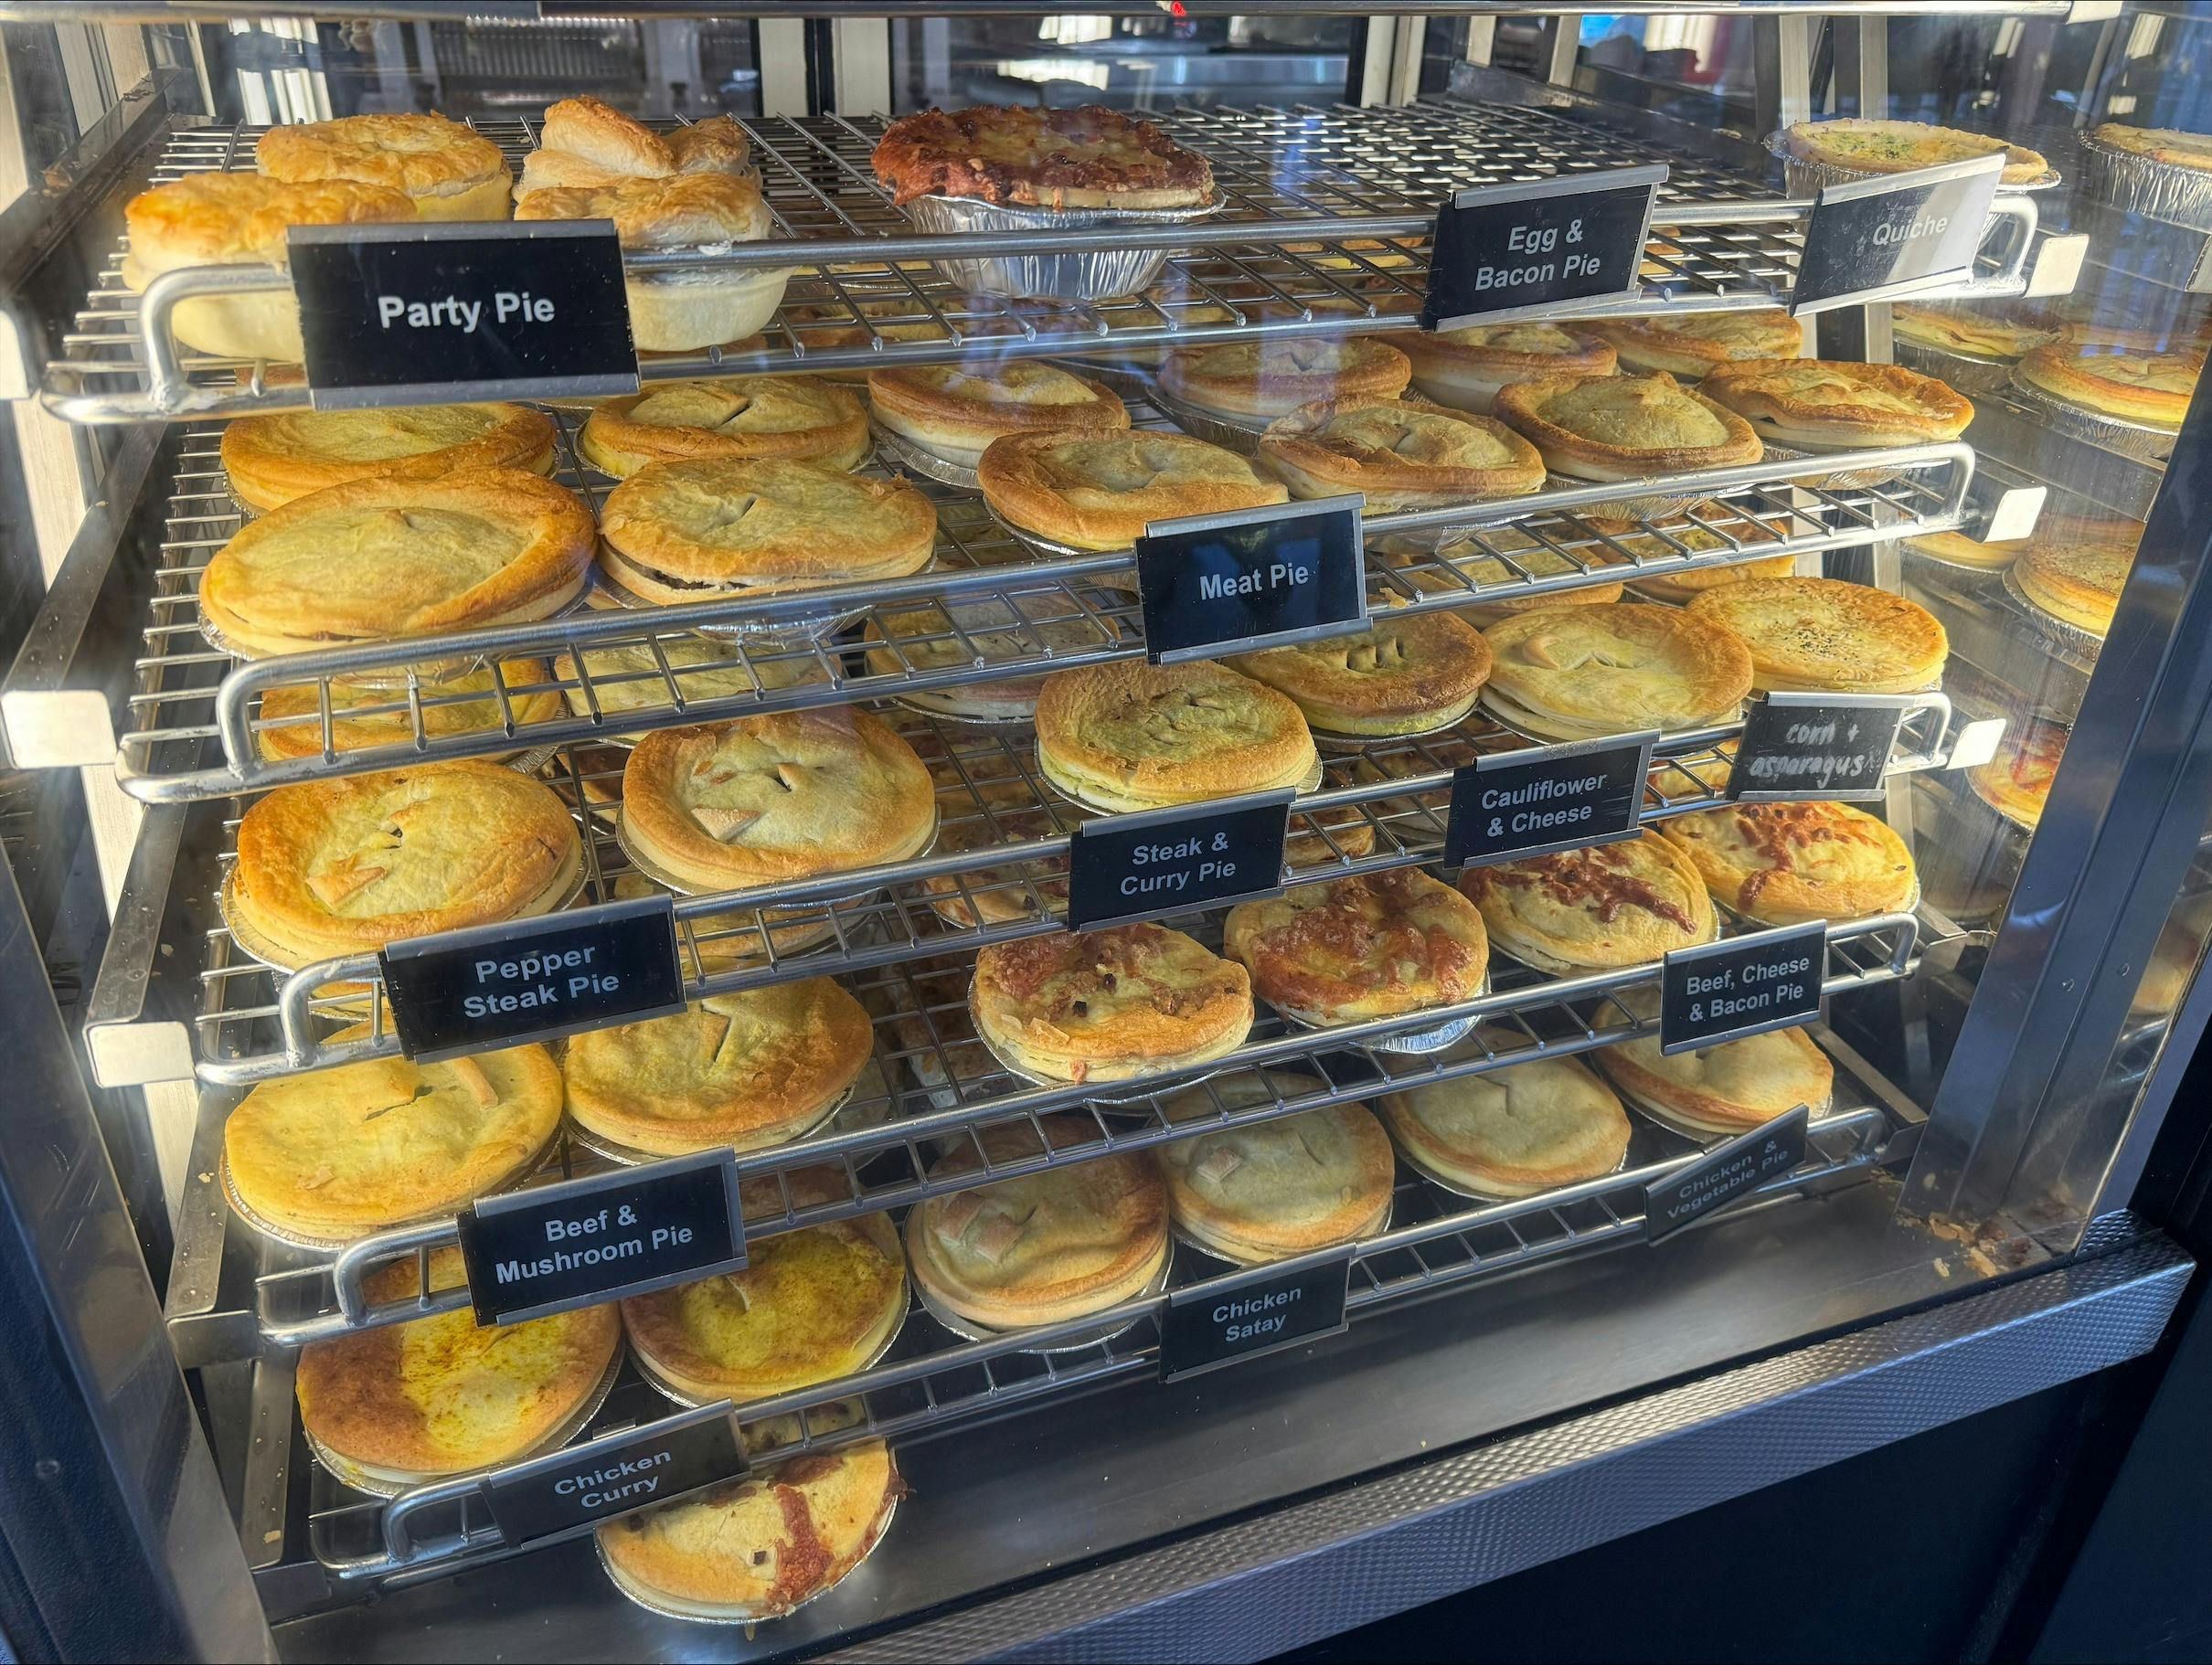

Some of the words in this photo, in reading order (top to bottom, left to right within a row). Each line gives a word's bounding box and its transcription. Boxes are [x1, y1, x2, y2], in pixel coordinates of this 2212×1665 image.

[1507, 226, 1558, 256] Egg
[1565, 218, 1583, 244] &
[1873, 215, 1948, 246] Quiche
[1474, 263, 1555, 292] Bacon
[1562, 253, 1601, 280] Pie
[378, 294, 482, 334] Party
[495, 292, 555, 323] Pie
[1199, 568, 1263, 600] Meat
[1270, 562, 1309, 589] Pie
[1786, 723, 1835, 745] corn
[1749, 754, 1865, 790] asparagus
[1482, 773, 1608, 811] Cauliflower
[1486, 816, 1504, 838] &
[1512, 805, 1592, 834] Cheese
[1132, 836, 1204, 865] Steak
[1211, 832, 1229, 852] &
[1120, 869, 1191, 896] Curry
[1198, 860, 1237, 882] Pie
[474, 946, 596, 983] Pepper
[1686, 970, 1736, 995] Beef,
[1742, 957, 1810, 984] Cheese
[463, 983, 558, 1018] Steak
[569, 973, 620, 999] Pie
[1689, 1002, 1704, 1023] &
[1710, 992, 1770, 1018] Bacon
[1776, 982, 1803, 1003] Pie
[1666, 1169, 1756, 1218] Vegetable
[1761, 1150, 1788, 1171] Pie
[1678, 1155, 1752, 1199] Chicken
[1764, 1140, 1778, 1153] &
[545, 1209, 609, 1242] Beef
[617, 1204, 638, 1226] &
[495, 1239, 643, 1285] Mushroom
[651, 1225, 694, 1251] Pie
[1212, 1288, 1302, 1323] Chicken
[1225, 1314, 1287, 1342] Satay
[554, 1451, 672, 1496] Chicken
[580, 1476, 659, 1509] Curry
